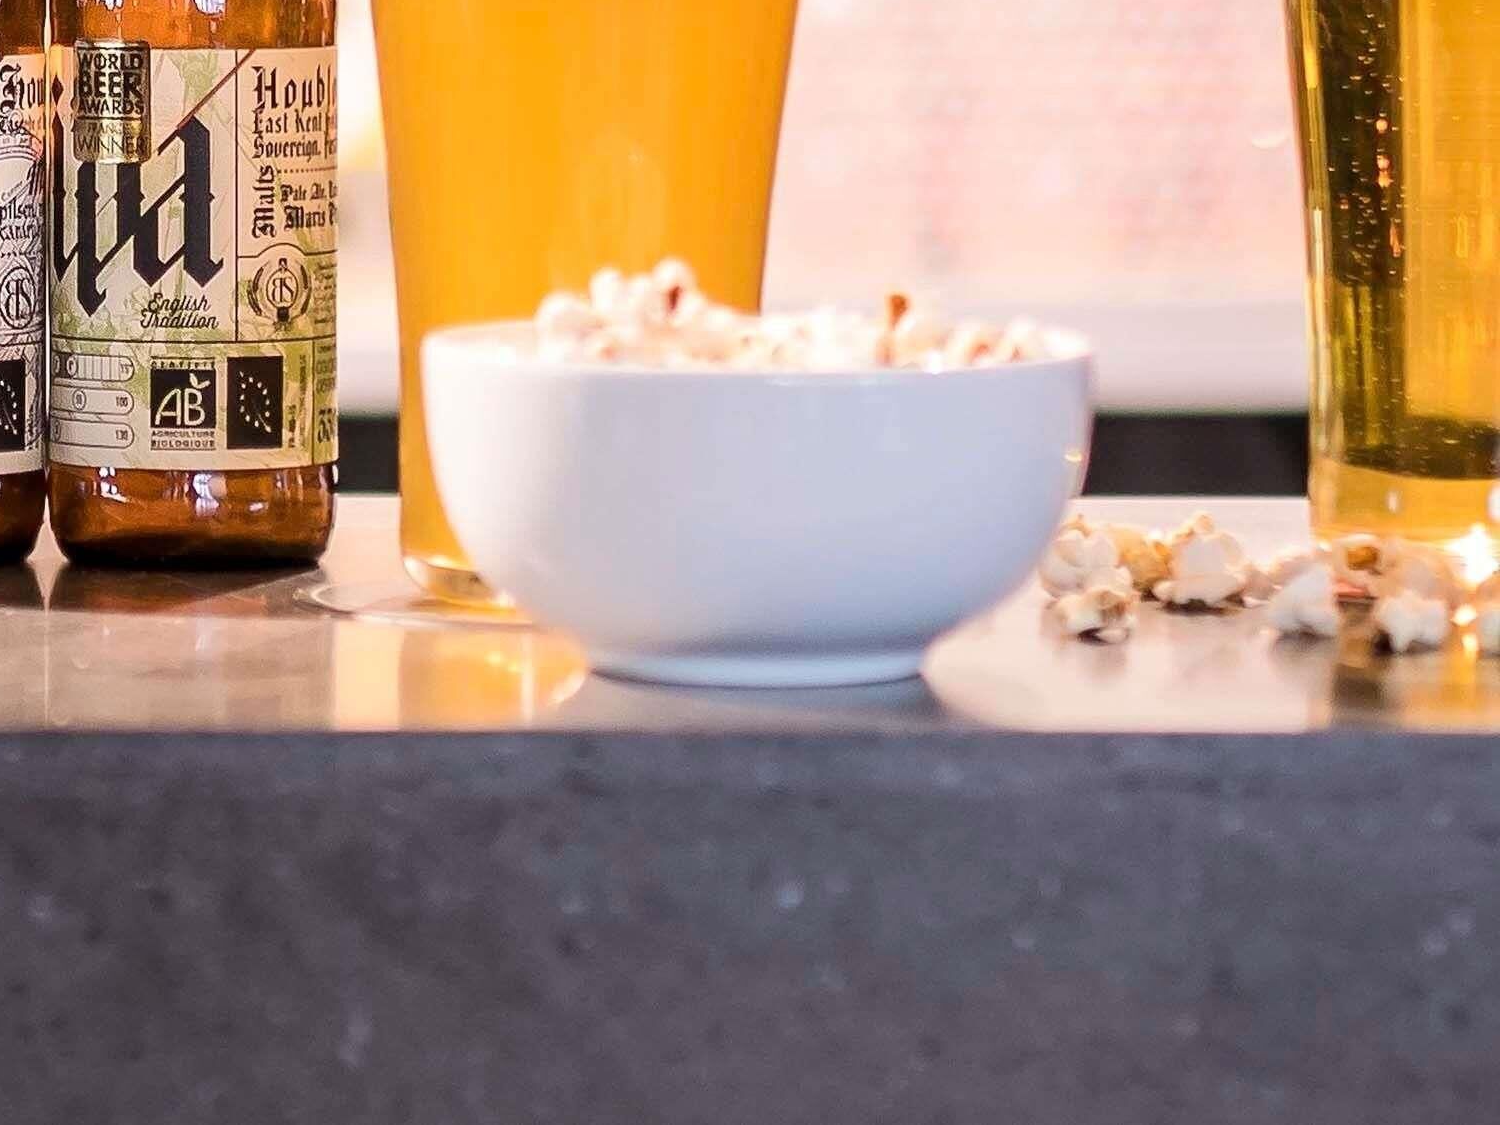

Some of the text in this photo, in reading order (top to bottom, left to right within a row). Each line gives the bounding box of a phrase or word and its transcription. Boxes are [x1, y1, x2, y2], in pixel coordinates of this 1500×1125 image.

[78, 53, 144, 70] WORLD
[78, 71, 144, 97] BEER
[78, 99, 145, 114] AWARDS
[76, 136, 148, 155] WINNER
[148, 292, 211, 317] English
[140, 308, 219, 330] Tradition
[155, 387, 206, 426] AB
